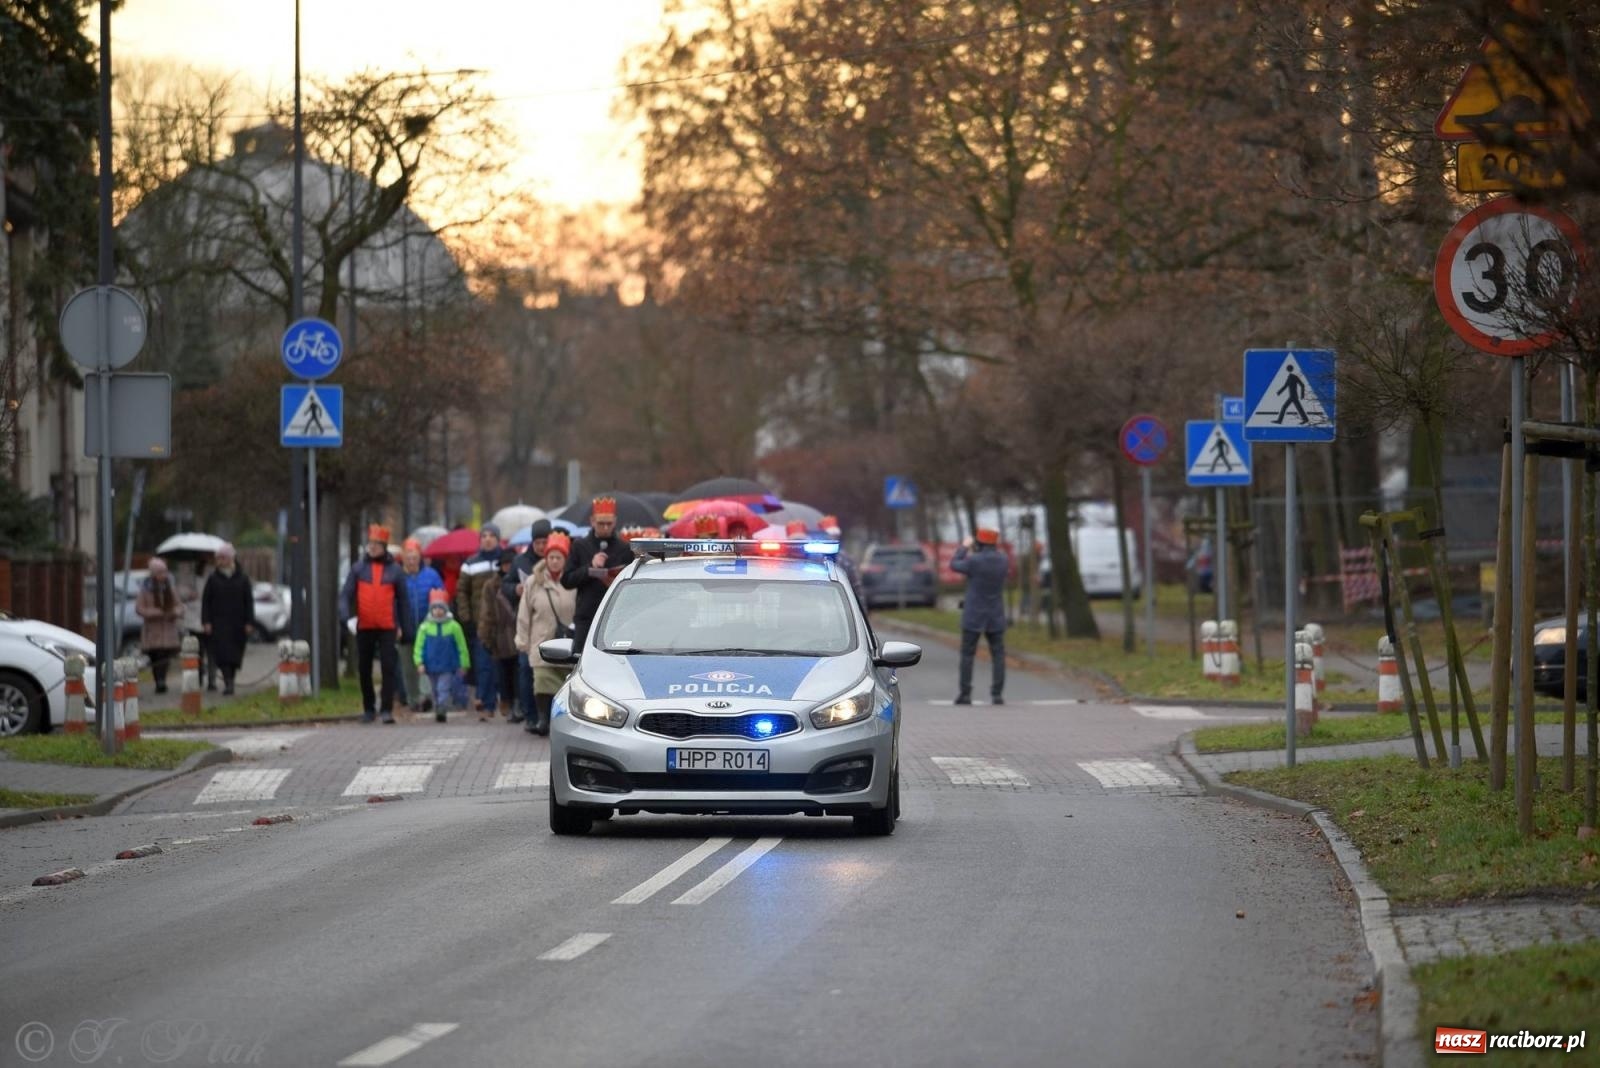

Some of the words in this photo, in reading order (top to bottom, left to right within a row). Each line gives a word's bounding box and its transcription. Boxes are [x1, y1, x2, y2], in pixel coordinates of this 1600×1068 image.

[1462, 240, 1577, 313] 30
[685, 544, 733, 552] POLICJA
[668, 683, 772, 695] POLICJA
[679, 751, 717, 768] HPP
[723, 752, 767, 769] R014
